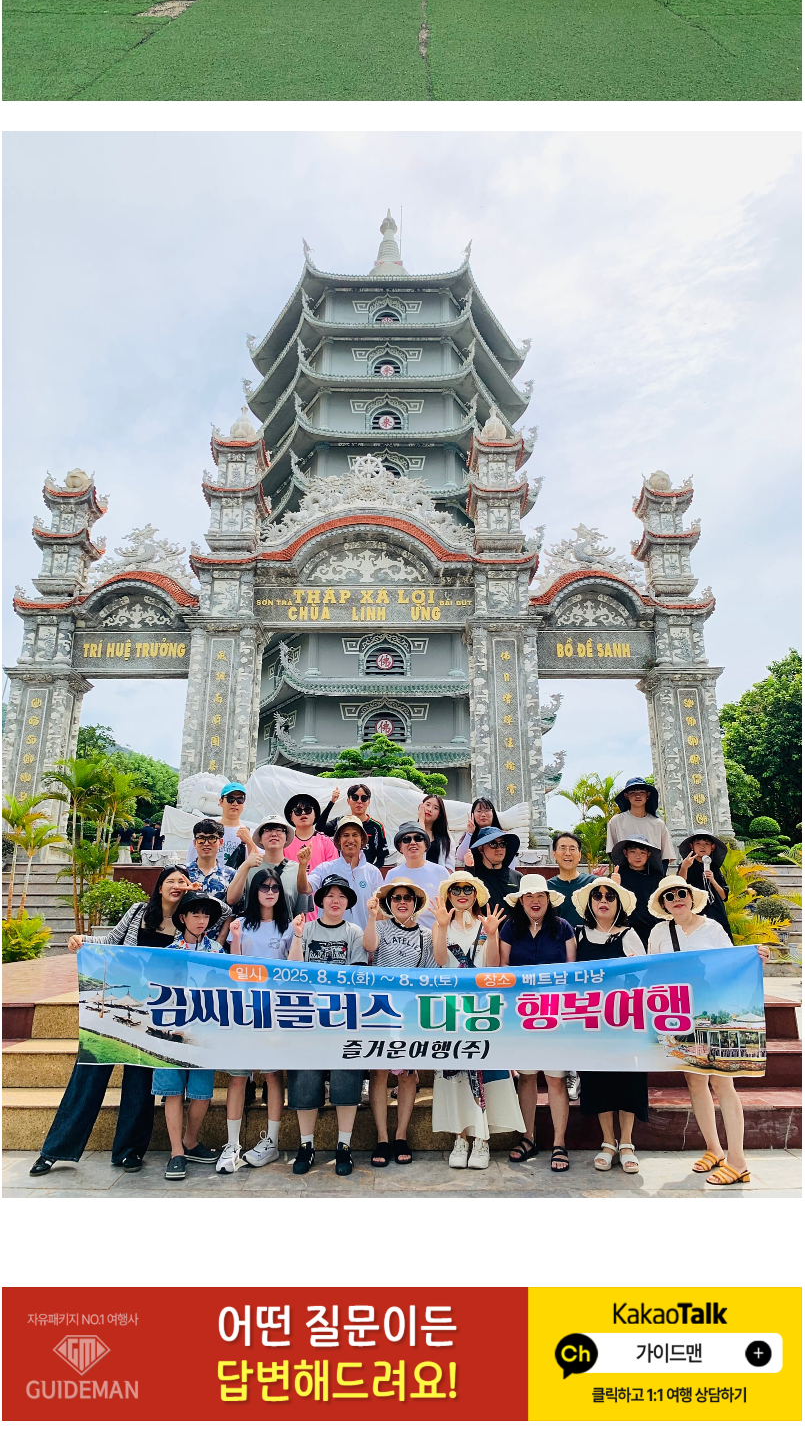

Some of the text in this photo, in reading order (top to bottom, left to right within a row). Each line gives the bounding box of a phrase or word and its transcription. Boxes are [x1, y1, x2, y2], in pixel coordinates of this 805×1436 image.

[288, 604, 330, 620] CHÙA
[352, 607, 386, 620] LINH
[83, 640, 102, 658] TRÍ
[106, 640, 131, 660] HUỆ
[597, 643, 630, 658] SANH
[236, 966, 262, 980] 일시
[273, 968, 312, 983] 2025.
[483, 974, 510, 986] 장소
[522, 968, 605, 986] 베트남 다낭
[147, 982, 694, 1032] 김씨네플러스 다낭 행복여행
[342, 1040, 490, 1060] 즐거운여행(주)
